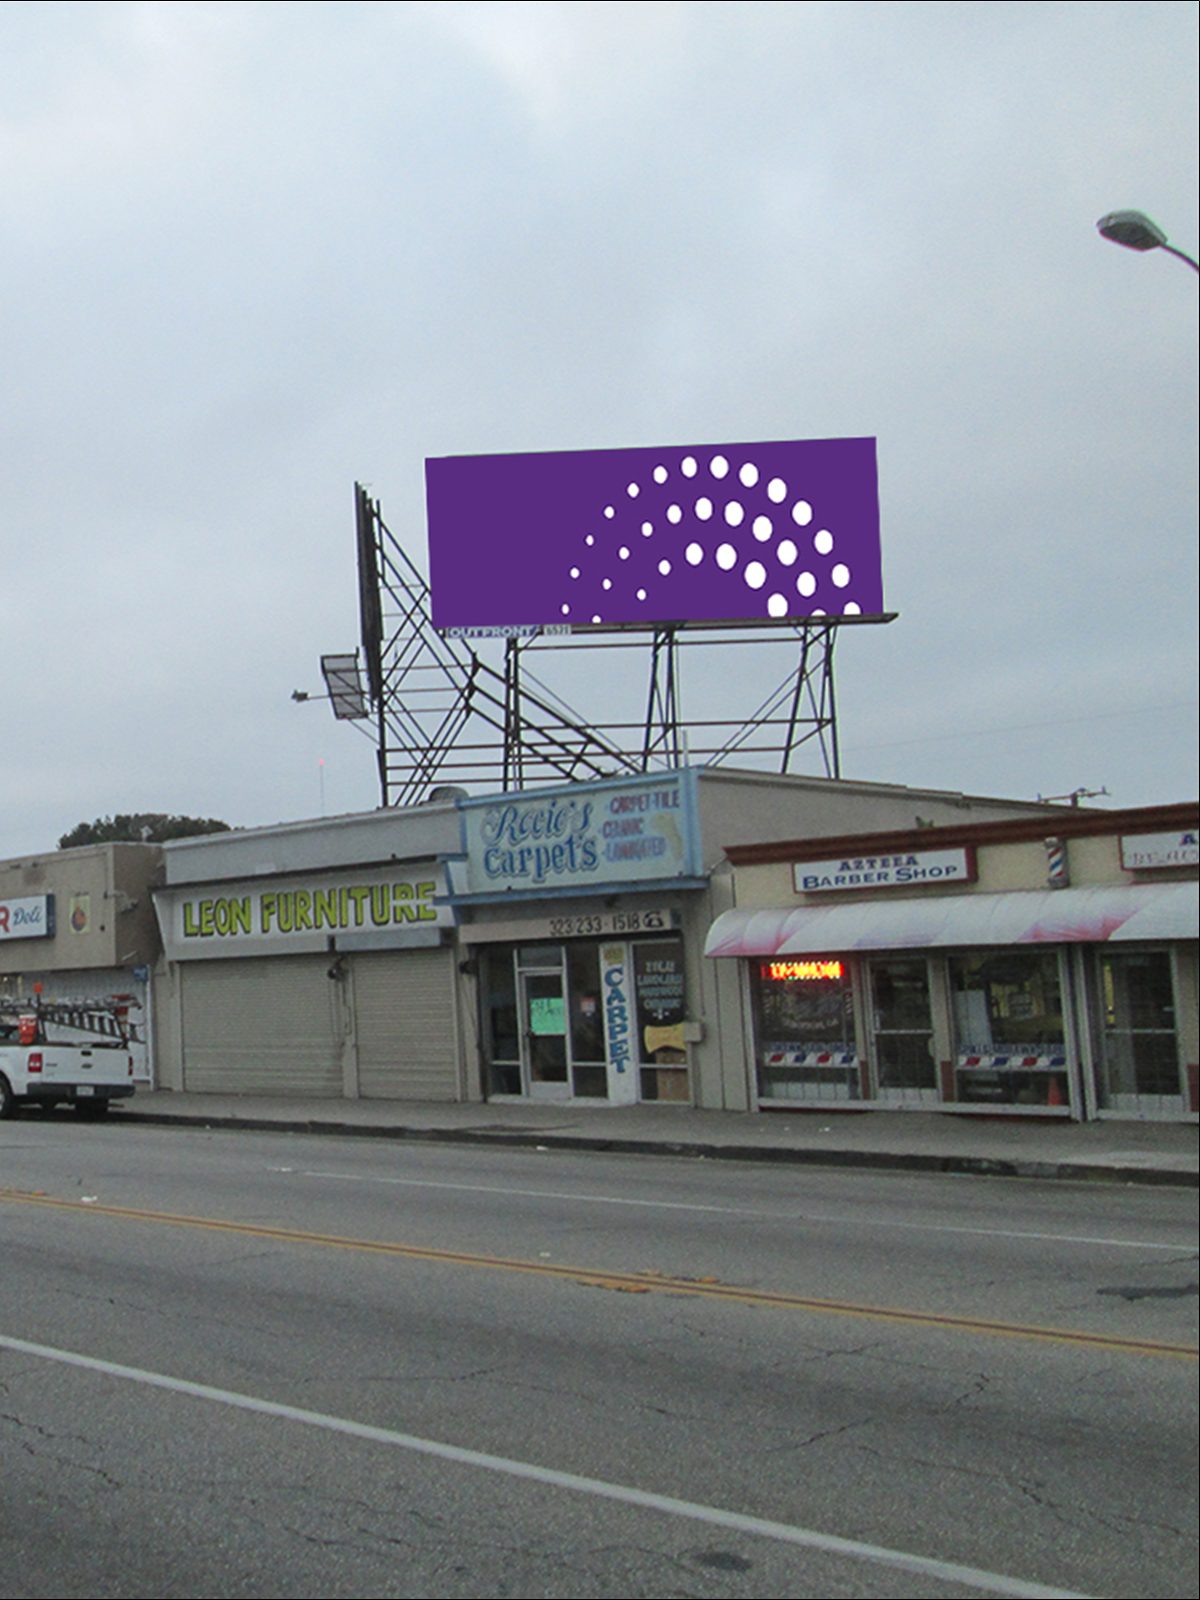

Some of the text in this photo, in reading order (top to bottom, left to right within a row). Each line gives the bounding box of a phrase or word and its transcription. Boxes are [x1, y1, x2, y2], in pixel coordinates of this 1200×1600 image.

[449, 626, 531, 638] OUTFRONT
[184, 881, 438, 937] LEON FURNITURE
[604, 967, 630, 1073] CARPET
